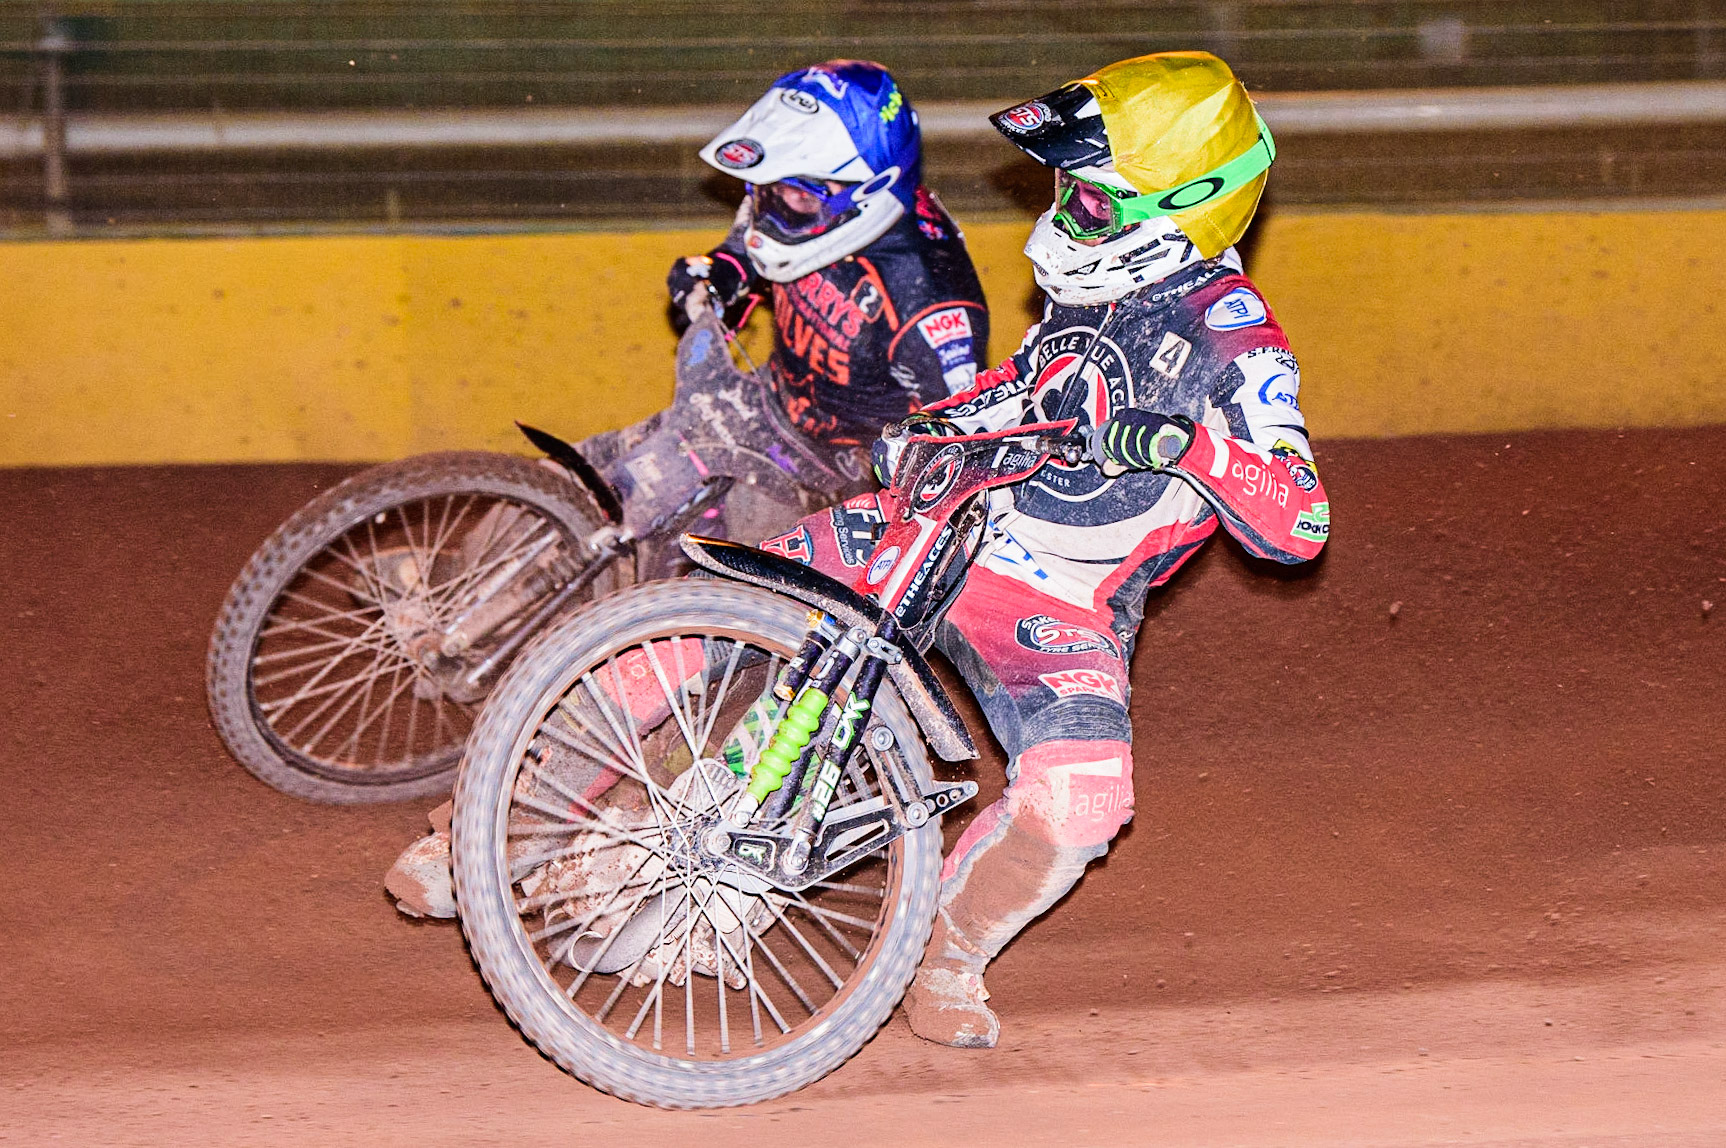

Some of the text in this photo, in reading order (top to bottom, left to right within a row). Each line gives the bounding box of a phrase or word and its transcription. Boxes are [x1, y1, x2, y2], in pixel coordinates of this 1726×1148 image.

[859, 286, 878, 313] 2
[1223, 298, 1251, 319] ATPI
[924, 312, 966, 337] NGK
[1159, 340, 1185, 373] 4
[1040, 469, 1071, 488] ESTER
[1231, 458, 1289, 509] agilia
[838, 526, 856, 565] Services
[894, 525, 953, 618] @THEACES
[1043, 672, 1117, 692] NGK
[1076, 784, 1131, 821] agilia
